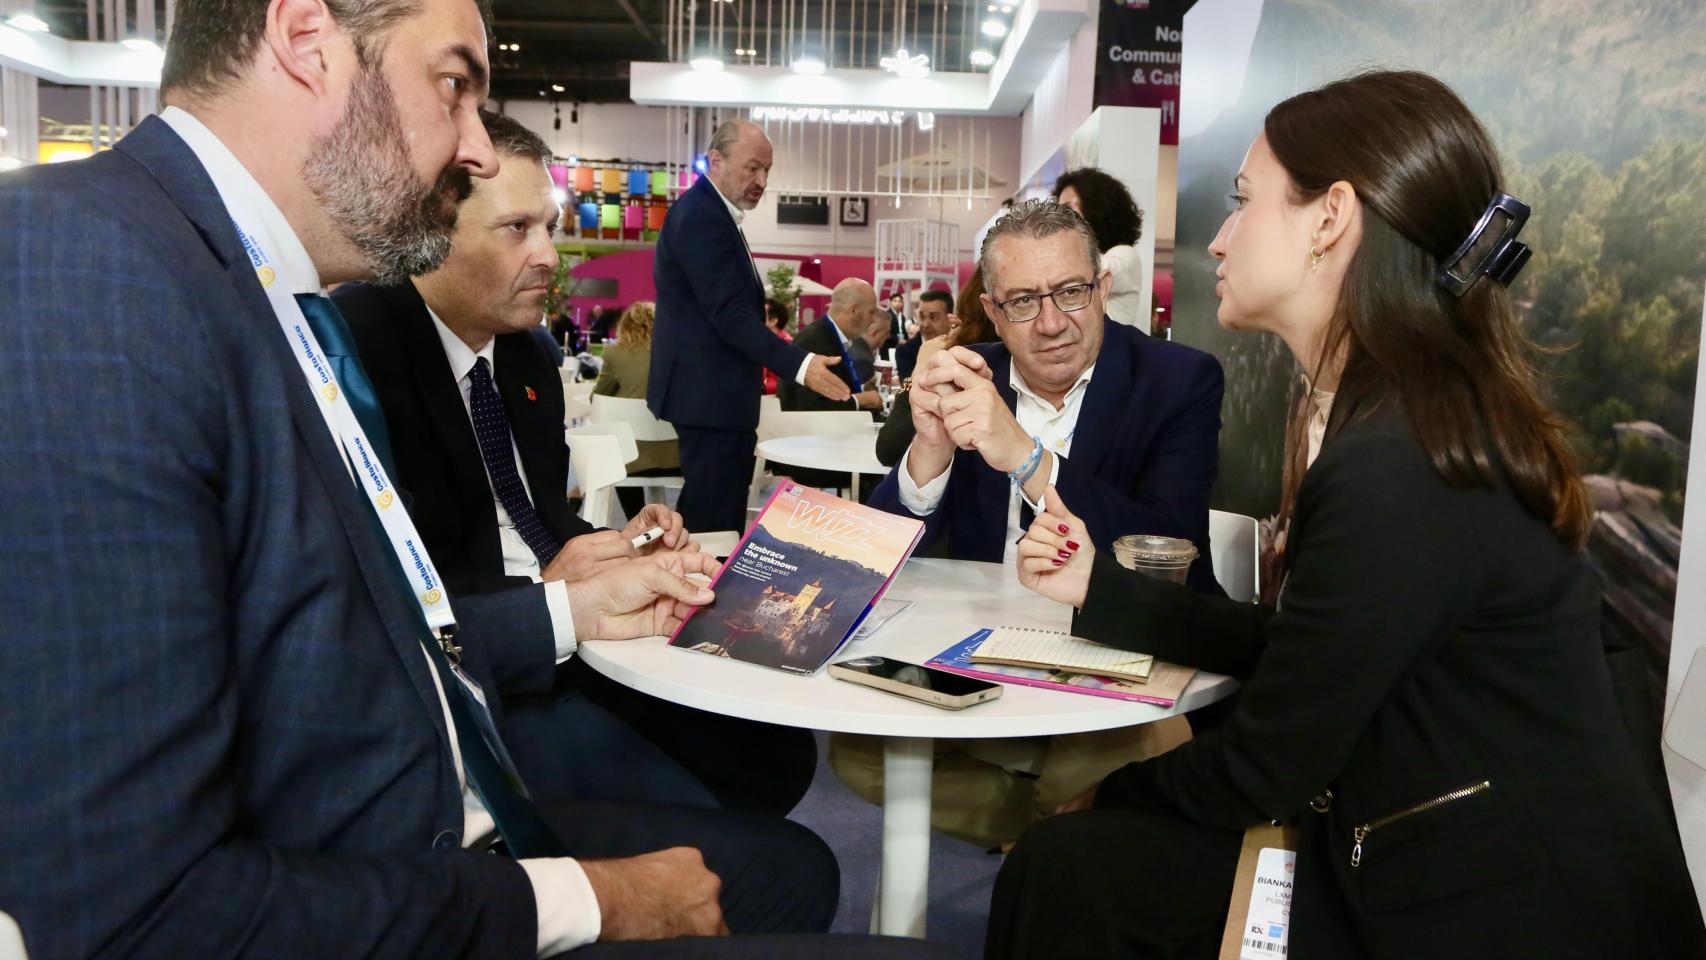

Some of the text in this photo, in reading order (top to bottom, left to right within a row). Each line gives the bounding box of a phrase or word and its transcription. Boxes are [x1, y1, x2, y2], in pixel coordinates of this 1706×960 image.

[1155, 25, 1182, 42] No
[1132, 68, 1146, 84] &
[747, 542, 786, 560] Embrace
[739, 556, 756, 565] near
[755, 561, 790, 577] Bucharest
[743, 548, 759, 559] the
[759, 555, 799, 572] unknown
[1257, 876, 1292, 889] BIANKA
